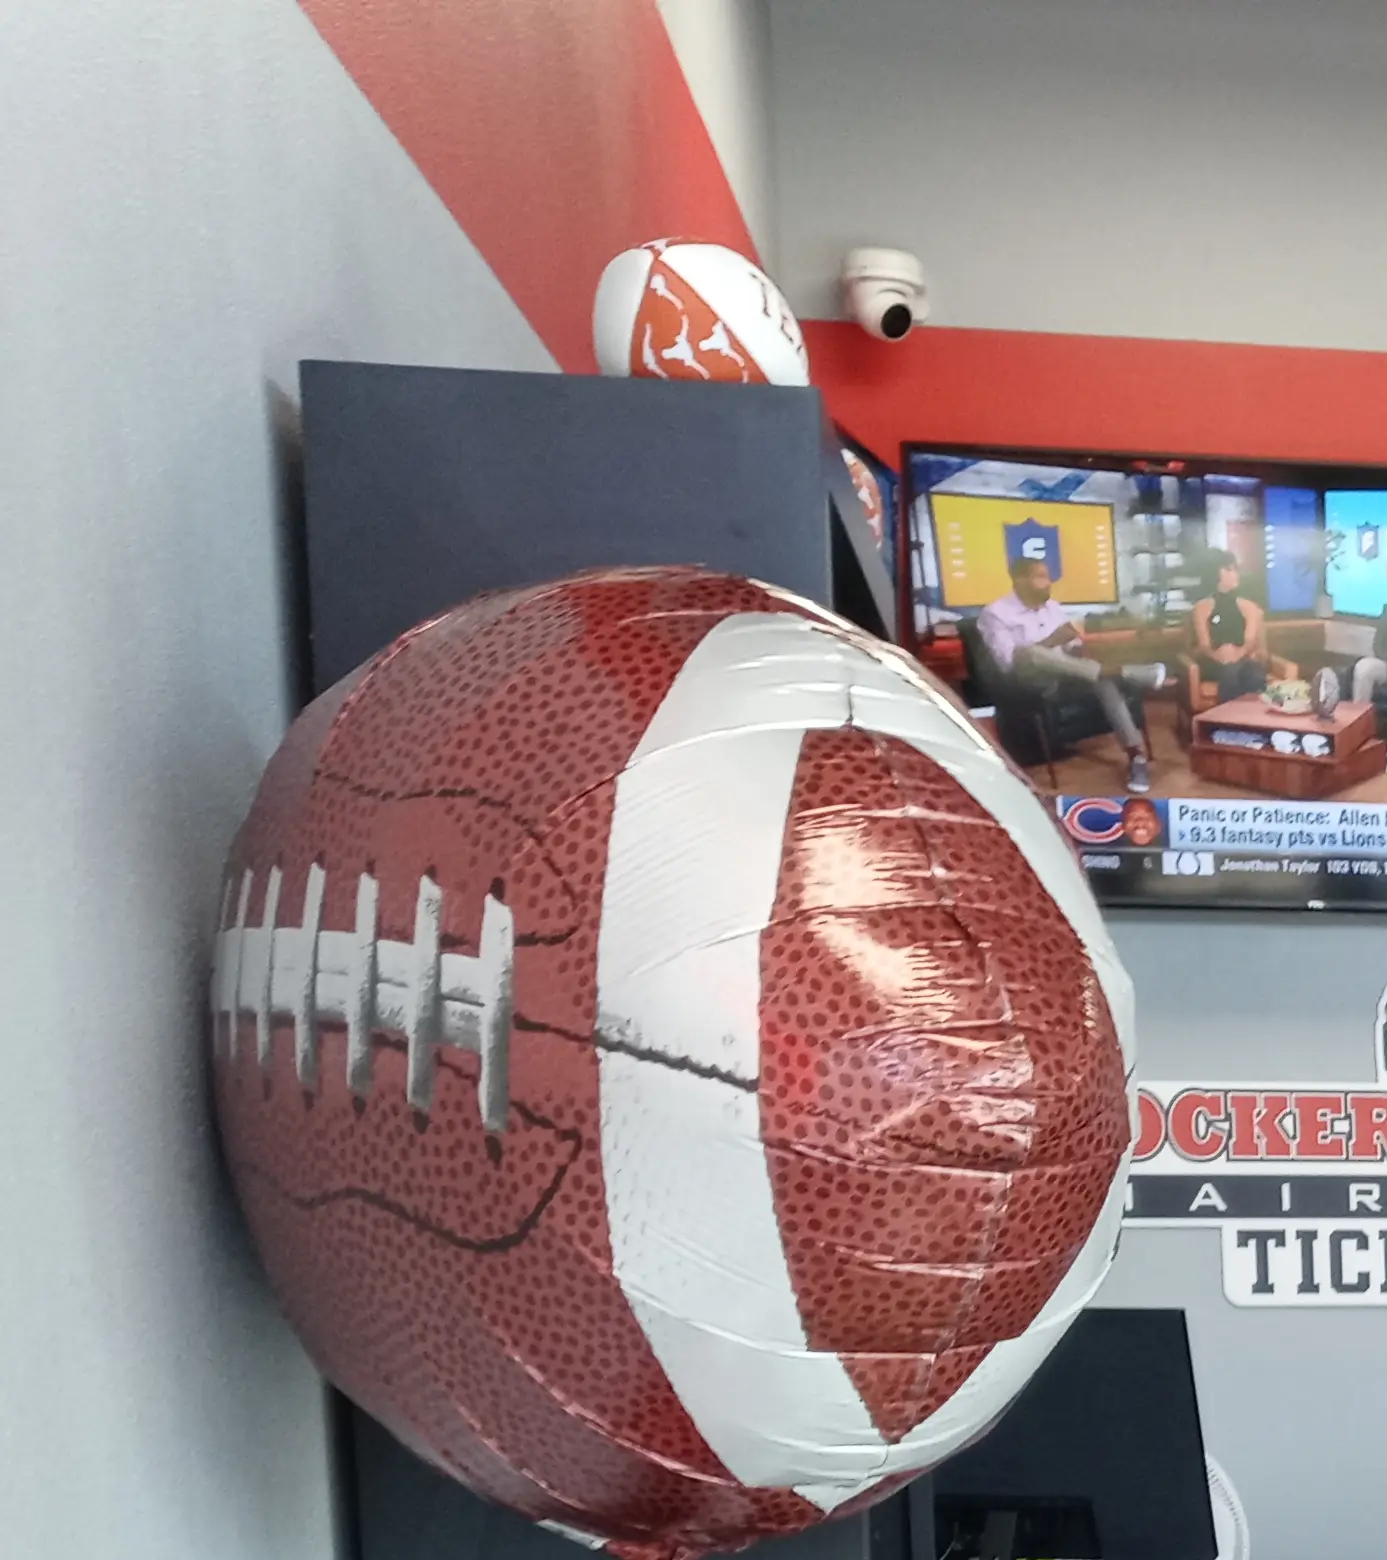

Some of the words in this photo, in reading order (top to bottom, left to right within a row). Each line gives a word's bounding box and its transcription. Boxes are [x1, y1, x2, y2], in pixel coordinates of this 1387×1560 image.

[1178, 804, 1227, 823] Panic
[1230, 807, 1250, 824] or
[1252, 805, 1331, 826] Patience:
[1338, 808, 1380, 827] Allen
[1220, 826, 1283, 849] fantasy
[1288, 829, 1314, 849] pts
[1318, 832, 1338, 847] vs
[1341, 830, 1386, 848] Lions
